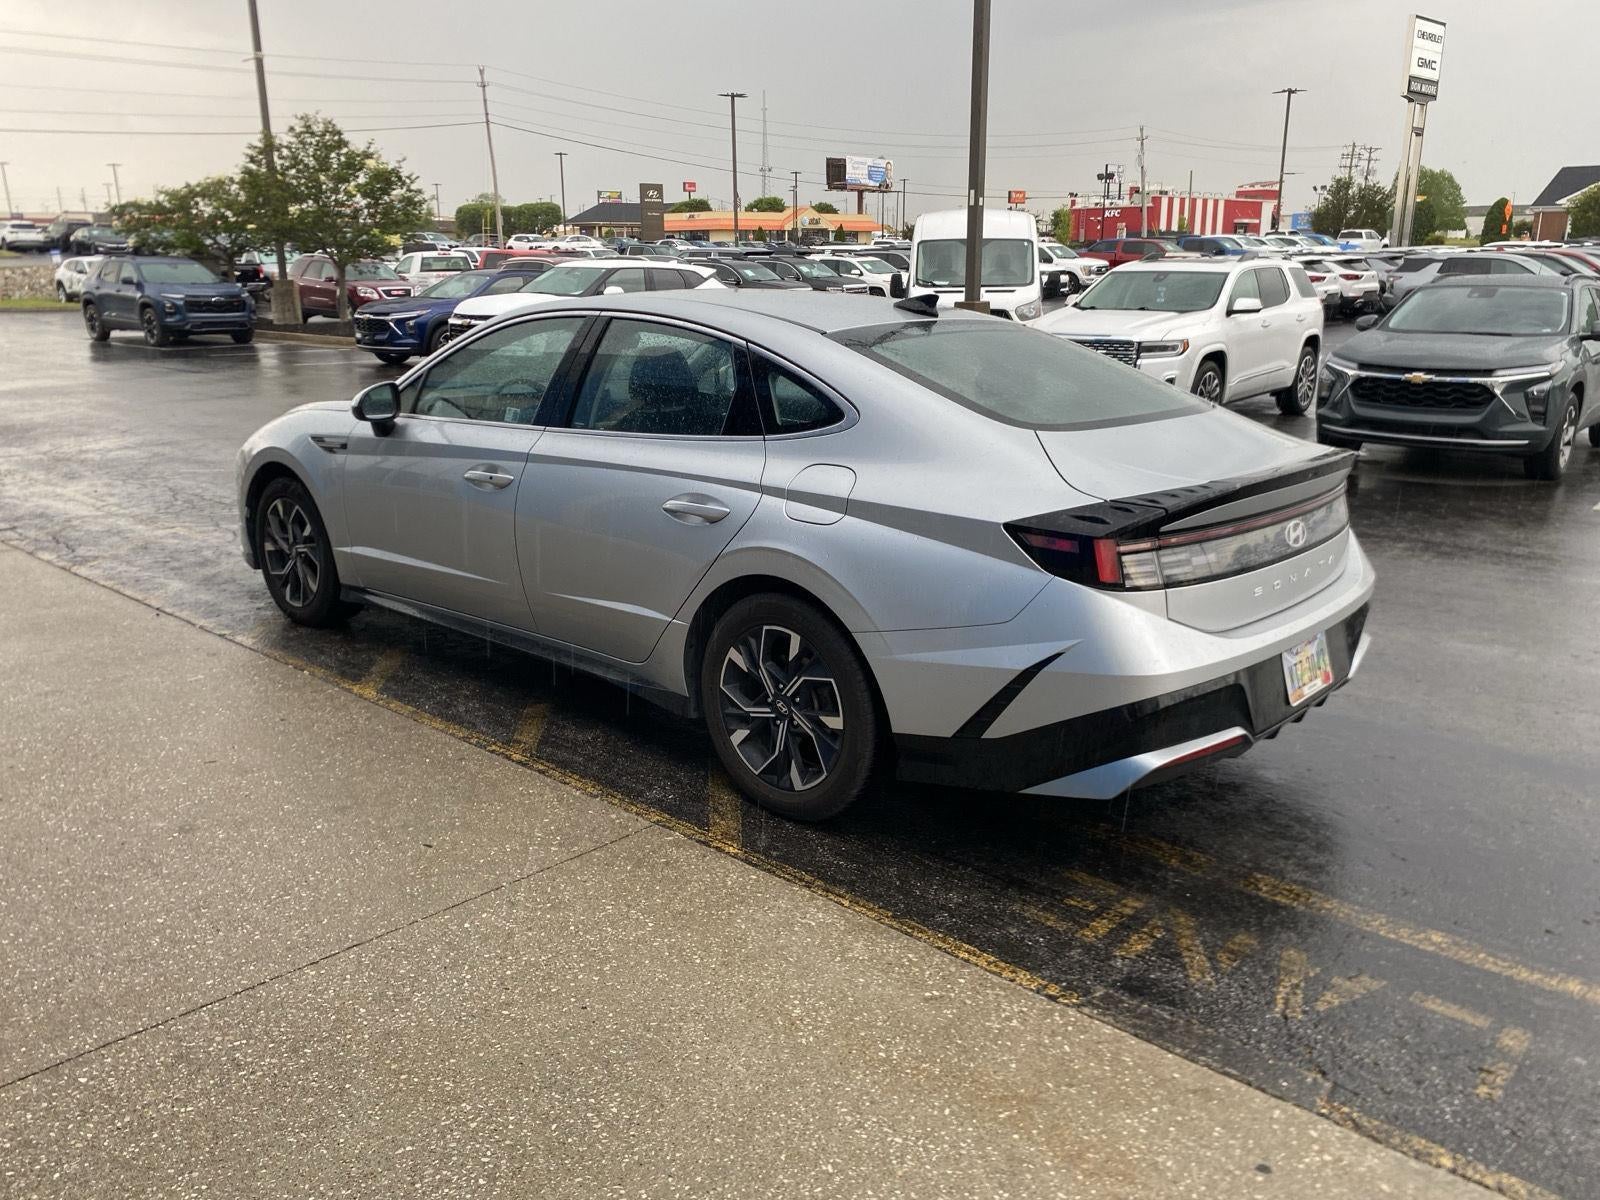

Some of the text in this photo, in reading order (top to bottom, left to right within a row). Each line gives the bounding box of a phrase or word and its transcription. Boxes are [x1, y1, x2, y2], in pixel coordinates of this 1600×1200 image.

[1417, 29, 1442, 44] CHEVROLET
[1417, 56, 1437, 71] GMC
[1104, 209, 1121, 218] KFC
